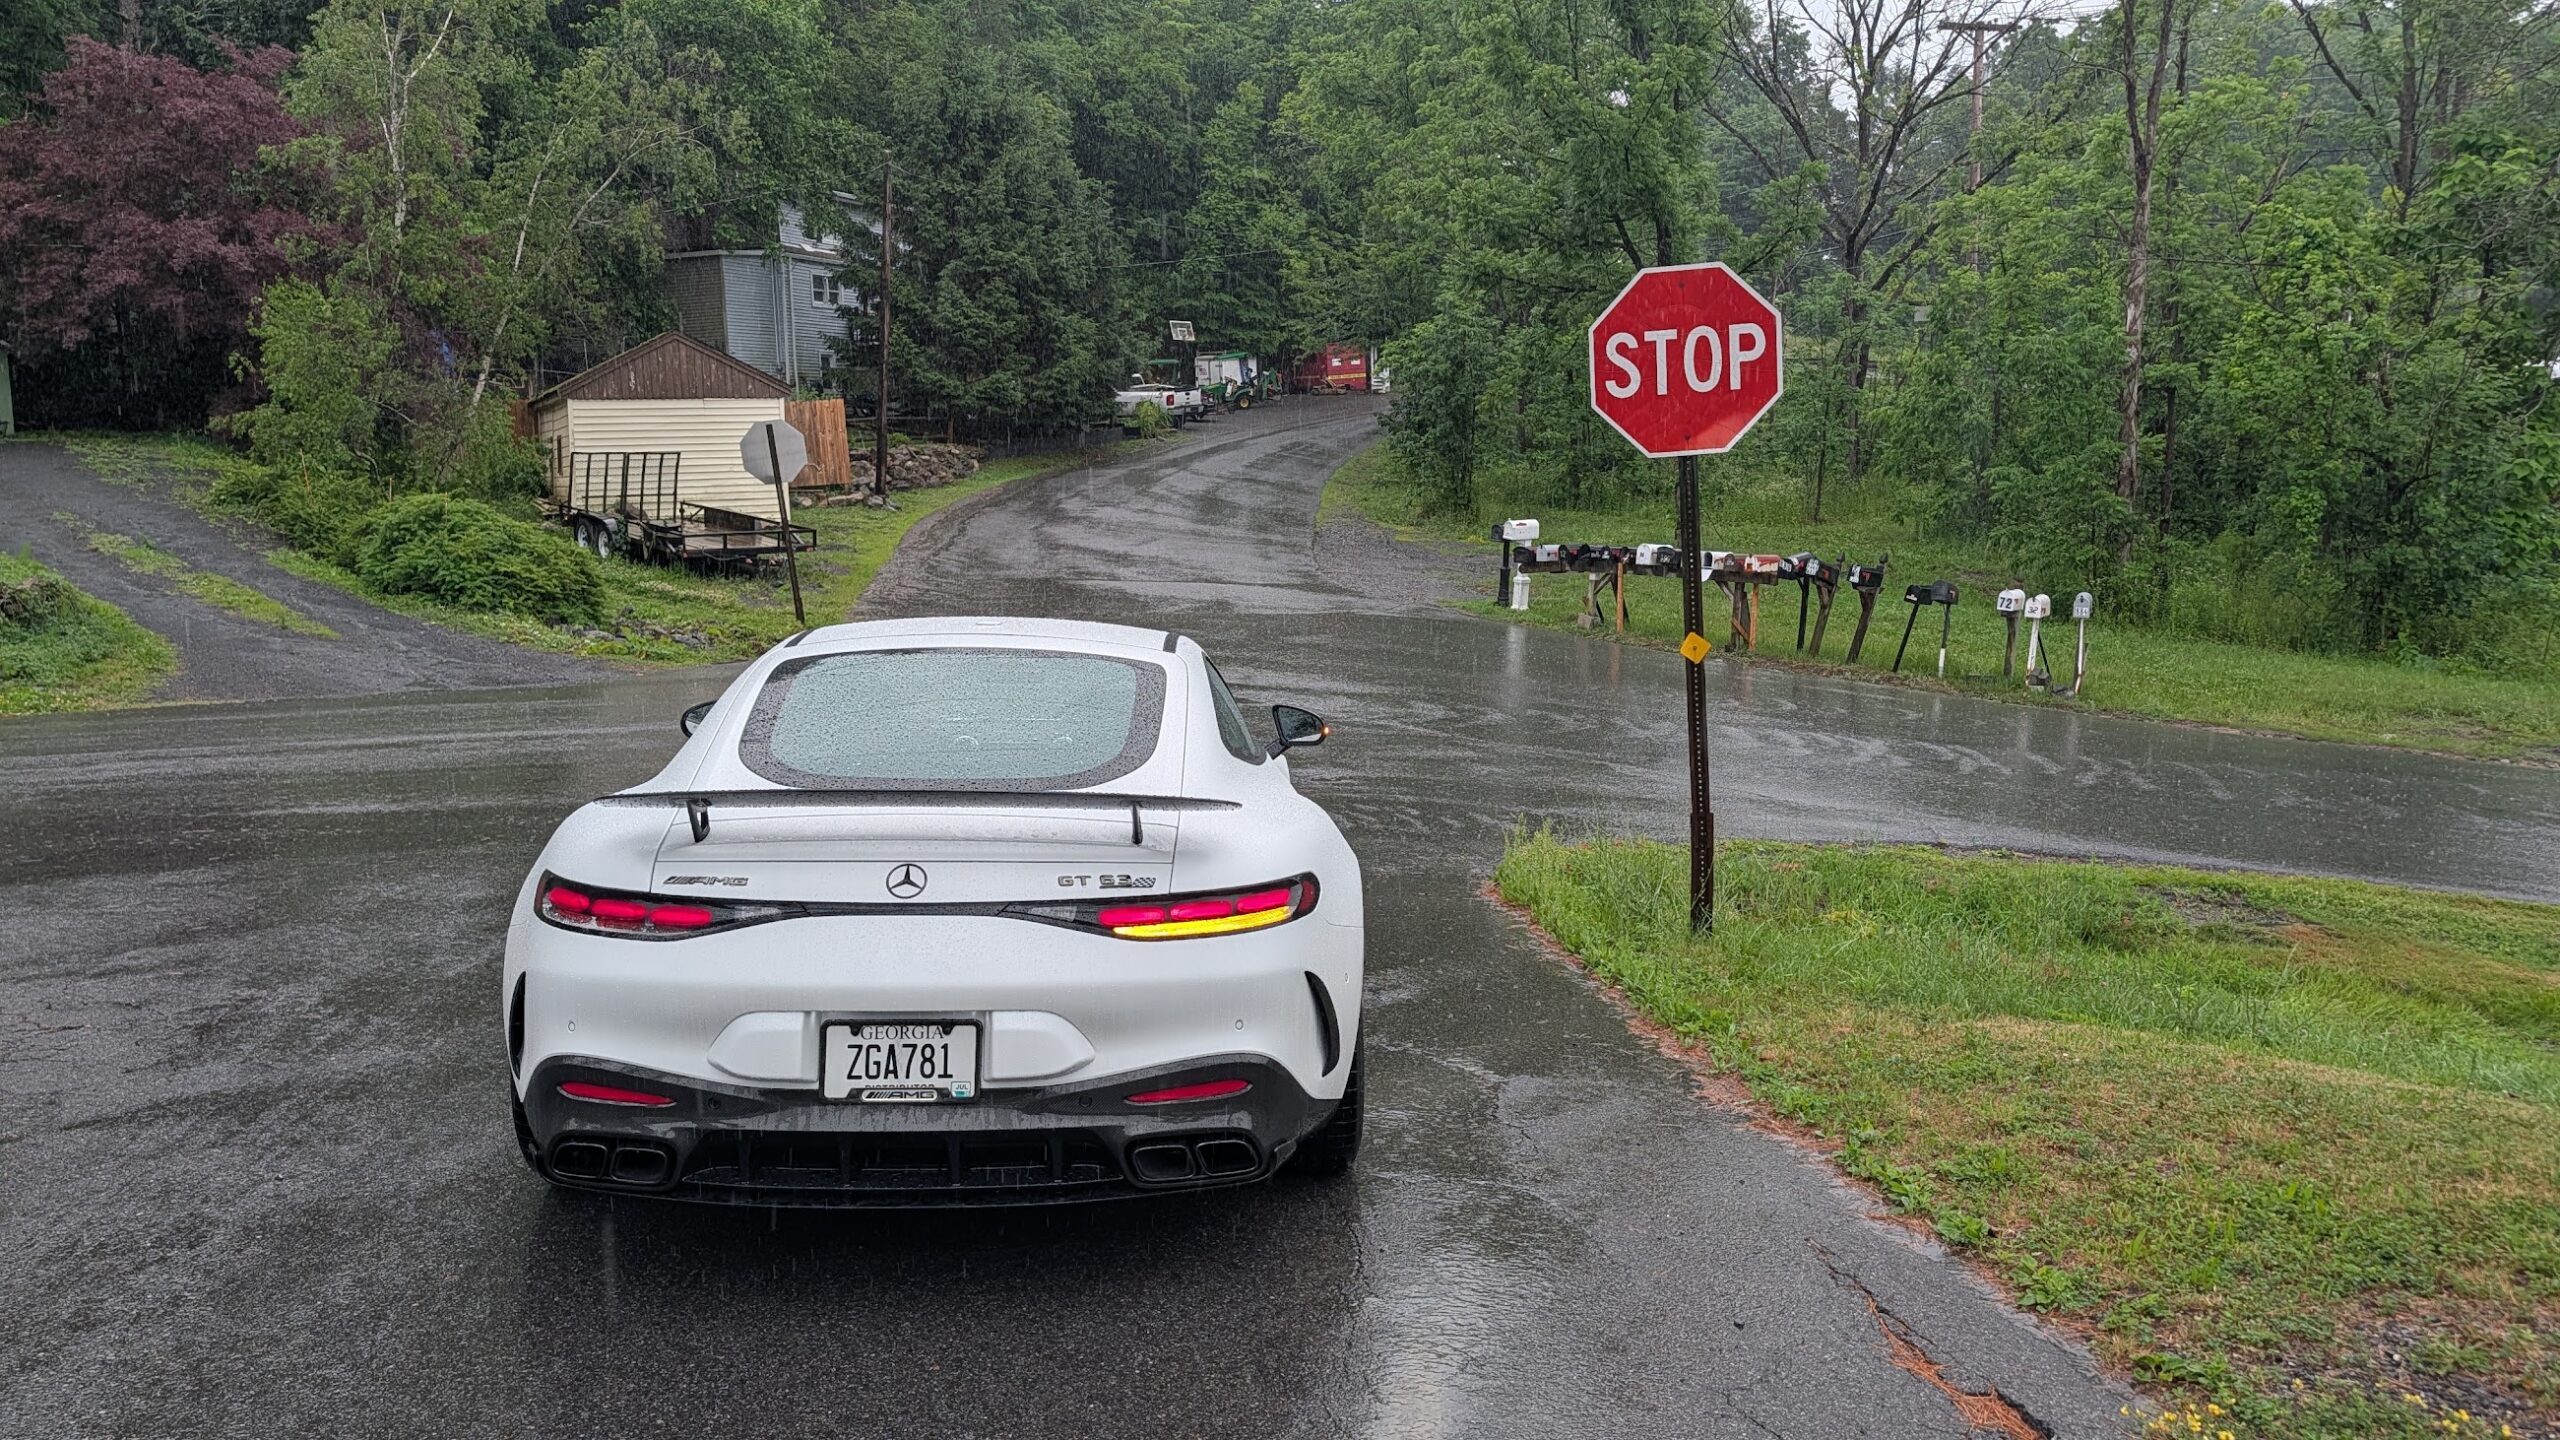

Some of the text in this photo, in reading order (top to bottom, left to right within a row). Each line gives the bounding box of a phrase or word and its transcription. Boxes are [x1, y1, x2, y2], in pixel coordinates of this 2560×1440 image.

[1605, 322, 1767, 399] STOP
[1999, 596, 2012, 610] 72
[1057, 874, 1132, 888] GT 63
[860, 1024, 945, 1040] GEORGIA
[847, 1042, 954, 1081] ZGA781
[955, 1083, 969, 1091] JUL
[887, 1090, 936, 1099] AMG
